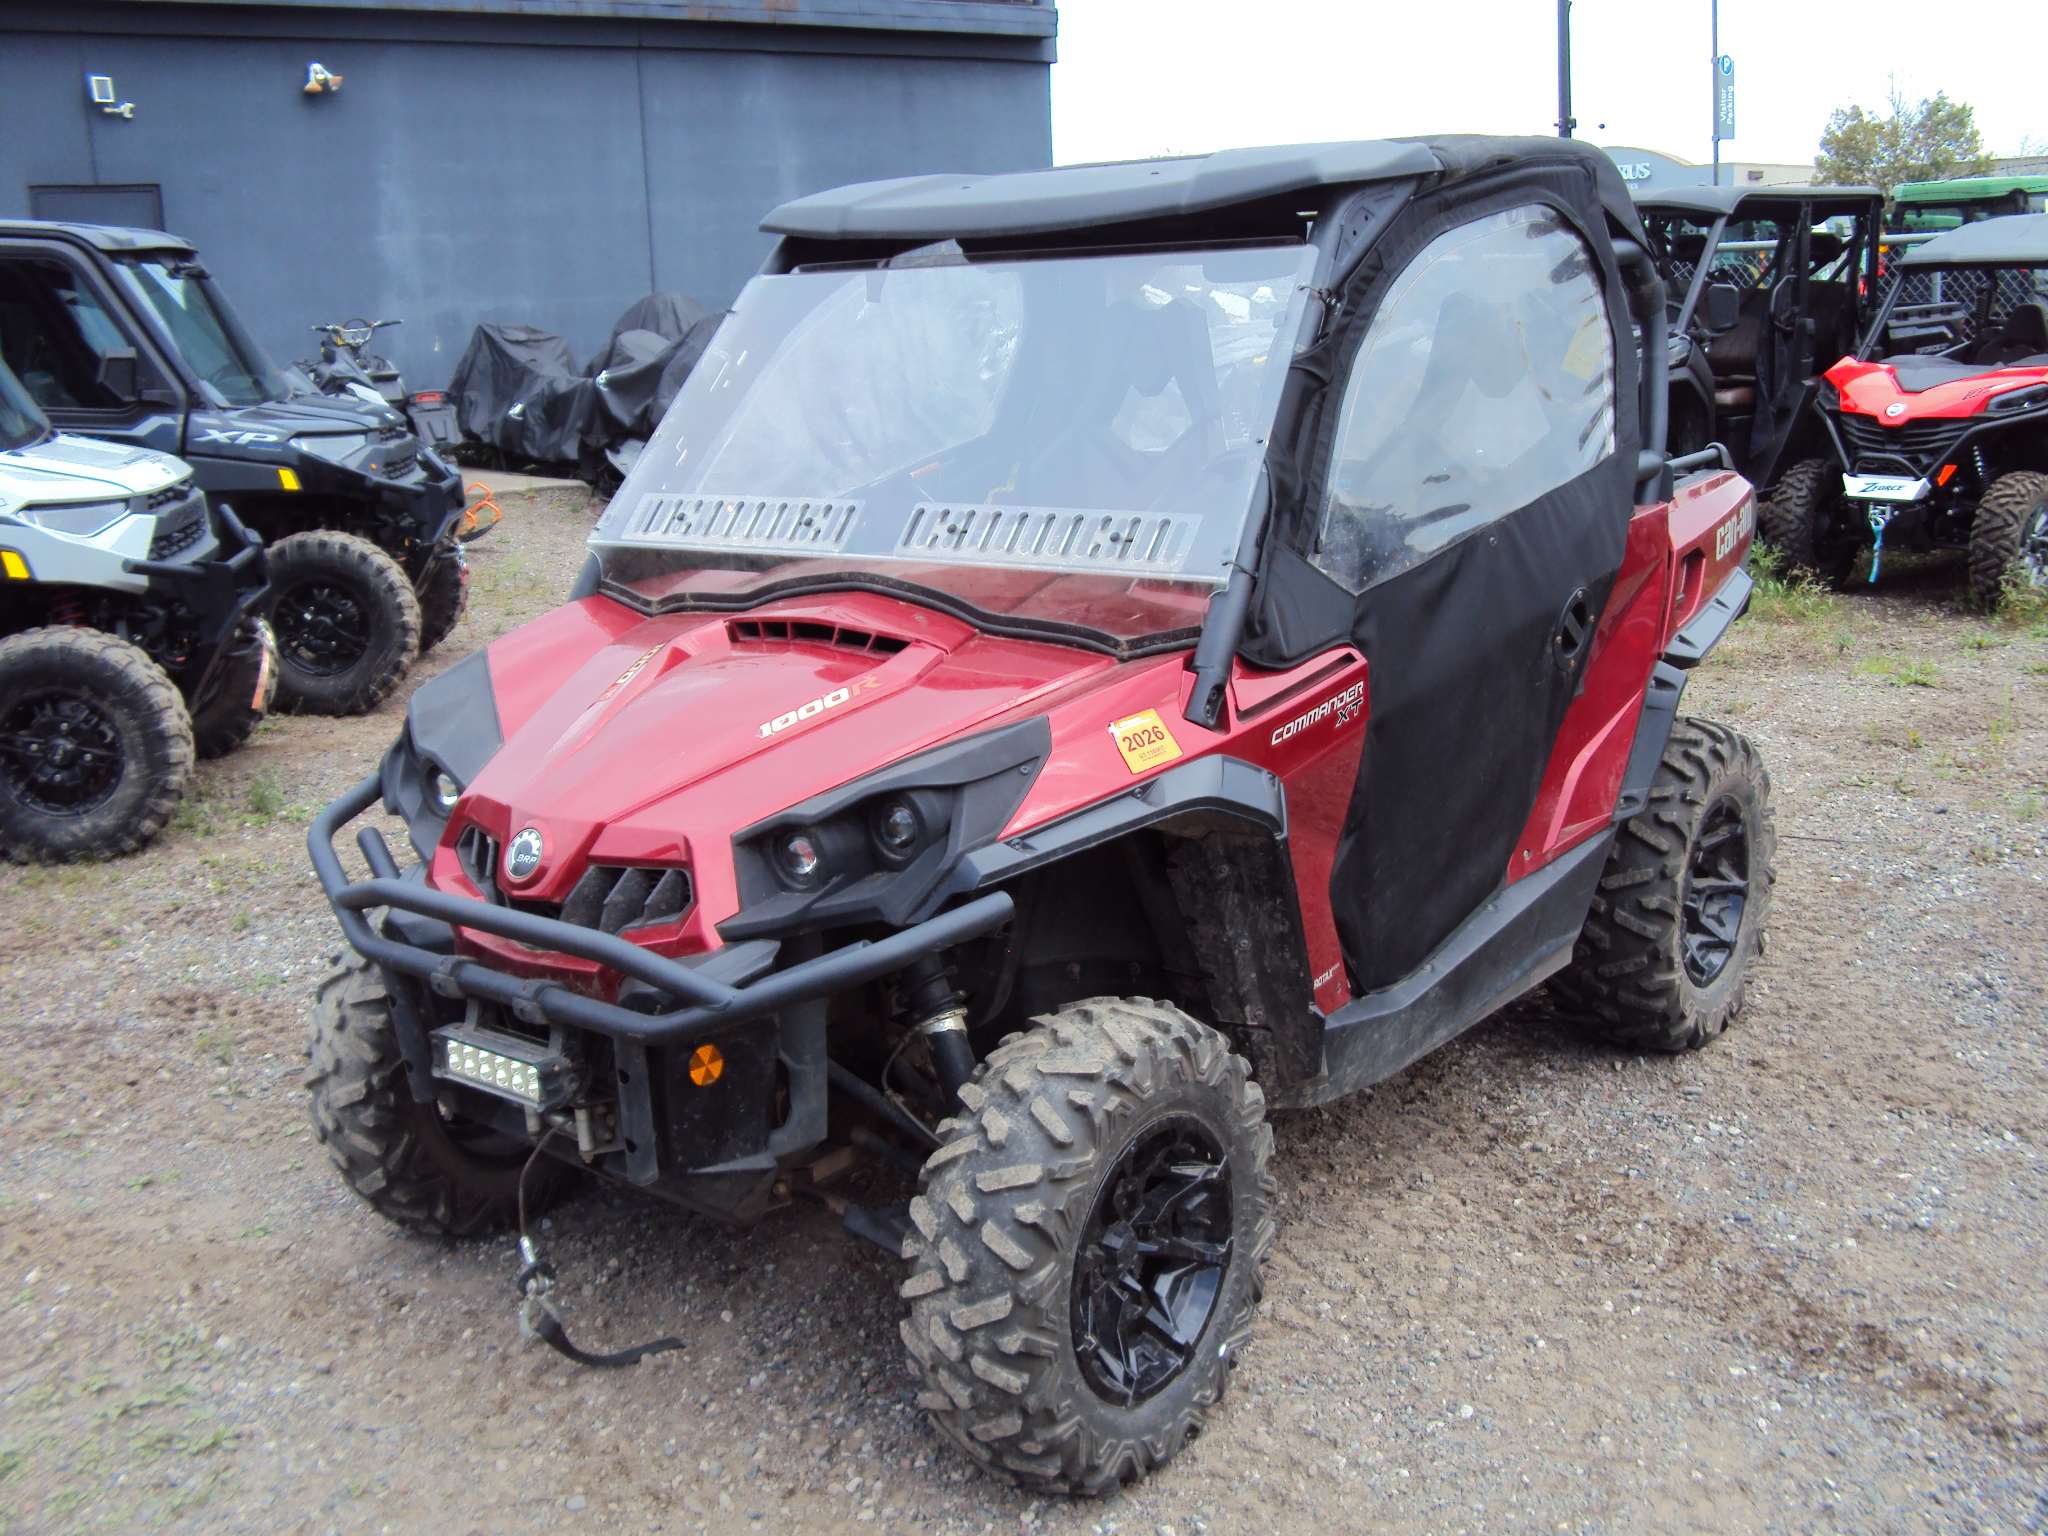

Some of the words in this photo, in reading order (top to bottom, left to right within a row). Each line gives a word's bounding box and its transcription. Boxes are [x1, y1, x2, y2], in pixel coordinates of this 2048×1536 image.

[193, 428, 279, 444] XP
[1271, 680, 1365, 747] COMMANDER
[1335, 698, 1364, 729] XT
[1122, 725, 1165, 752] 2026
[517, 854, 538, 863] BRP
